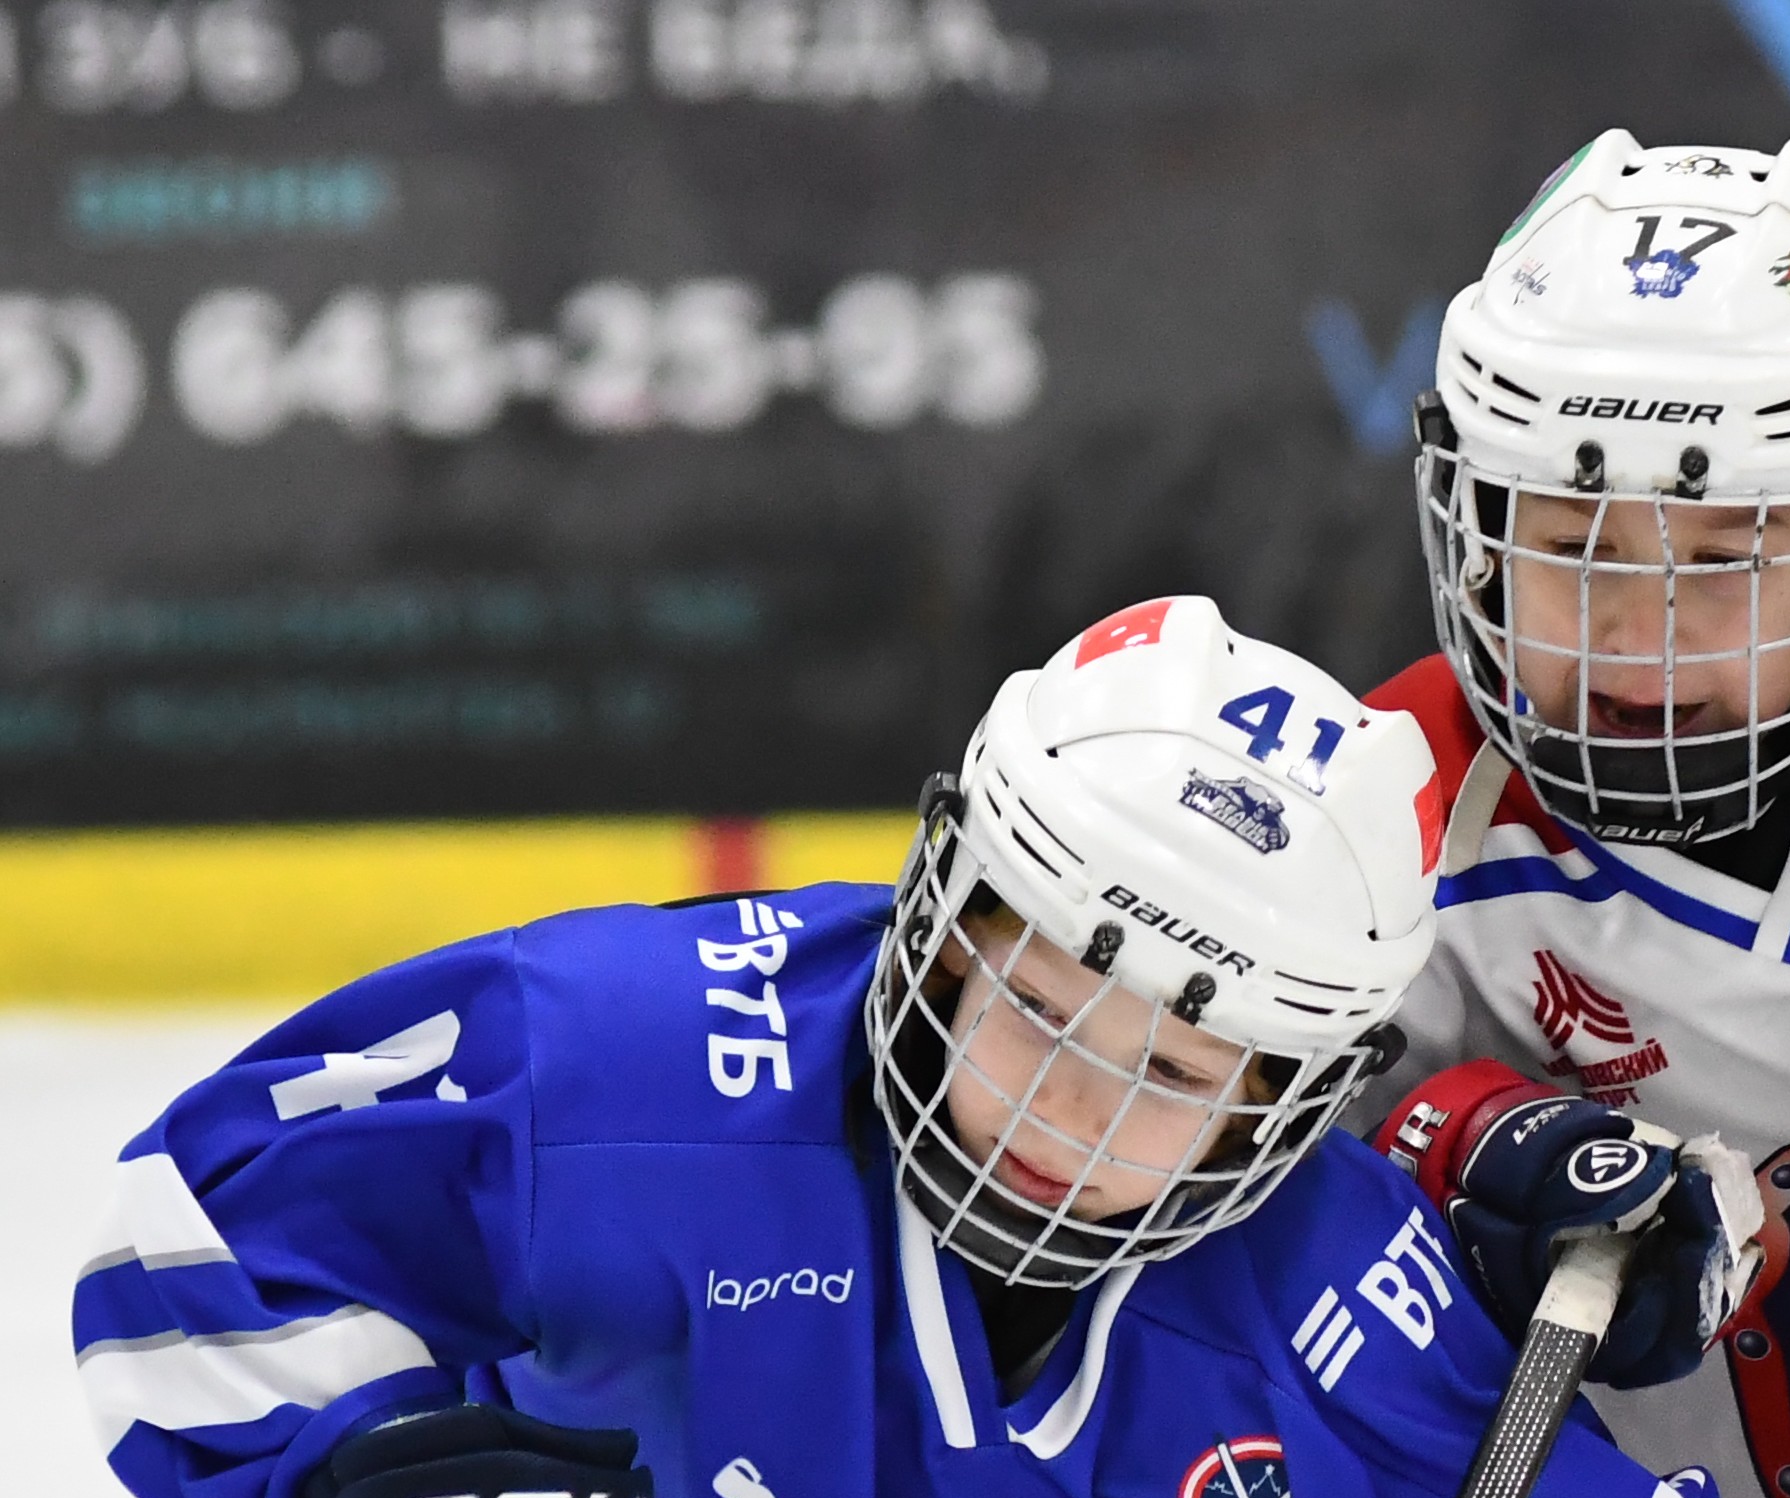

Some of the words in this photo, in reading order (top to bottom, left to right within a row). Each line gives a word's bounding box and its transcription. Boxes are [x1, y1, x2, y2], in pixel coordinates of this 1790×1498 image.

[1622, 215, 1738, 266] 17
[1558, 395, 1724, 426] BAUER
[1217, 684, 1347, 798] 41
[1100, 883, 1256, 978] BAUER
[696, 932, 794, 1099] ВТБ
[705, 1267, 855, 1313] laprad
